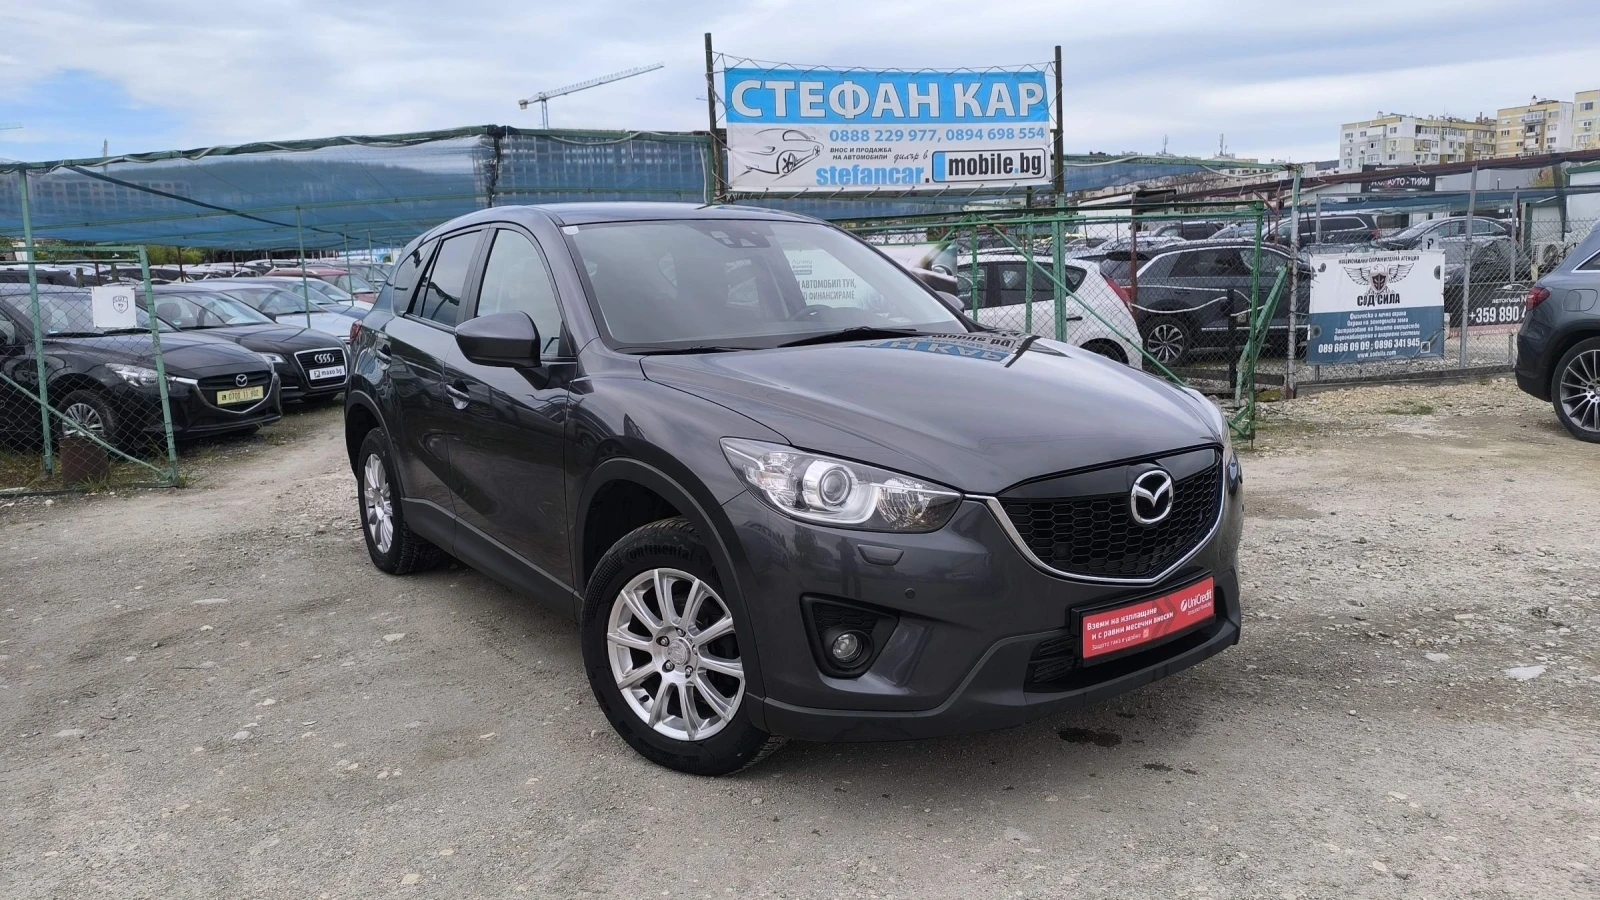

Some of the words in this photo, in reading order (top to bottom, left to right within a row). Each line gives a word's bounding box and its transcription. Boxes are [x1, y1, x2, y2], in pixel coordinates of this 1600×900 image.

[731, 79, 940, 120] СТЕФАН
[953, 82, 1044, 117] КАР
[829, 129, 870, 142] 0888
[874, 129, 904, 142] 229
[908, 128, 941, 143] 977,
[945, 128, 983, 141] 0894
[987, 127, 1015, 140] 698
[1018, 127, 1045, 139] 554
[948, 151, 1042, 176] mobile.bg
[801, 279, 841, 289] АВТОМОБИЛ
[809, 290, 855, 301] ФИНАНСИРАМЕ
[1377, 293, 1401, 305] СИЛА
[1468, 306, 1497, 323] +359
[1499, 305, 1519, 322] 890
[1318, 343, 1334, 353] 089
[1349, 341, 1360, 352] 09
[1374, 339, 1392, 350] 0896
[1393, 338, 1406, 348] 341
[1406, 337, 1420, 347] 945
[1187, 588, 1212, 609] UniCredit
[1087, 620, 1110, 631] Вземи
[1110, 617, 1120, 625] на
[1120, 607, 1158, 624] изплащане
[1103, 627, 1125, 640] равни
[1125, 620, 1153, 634] месечни
[1153, 611, 1174, 625] вноски
